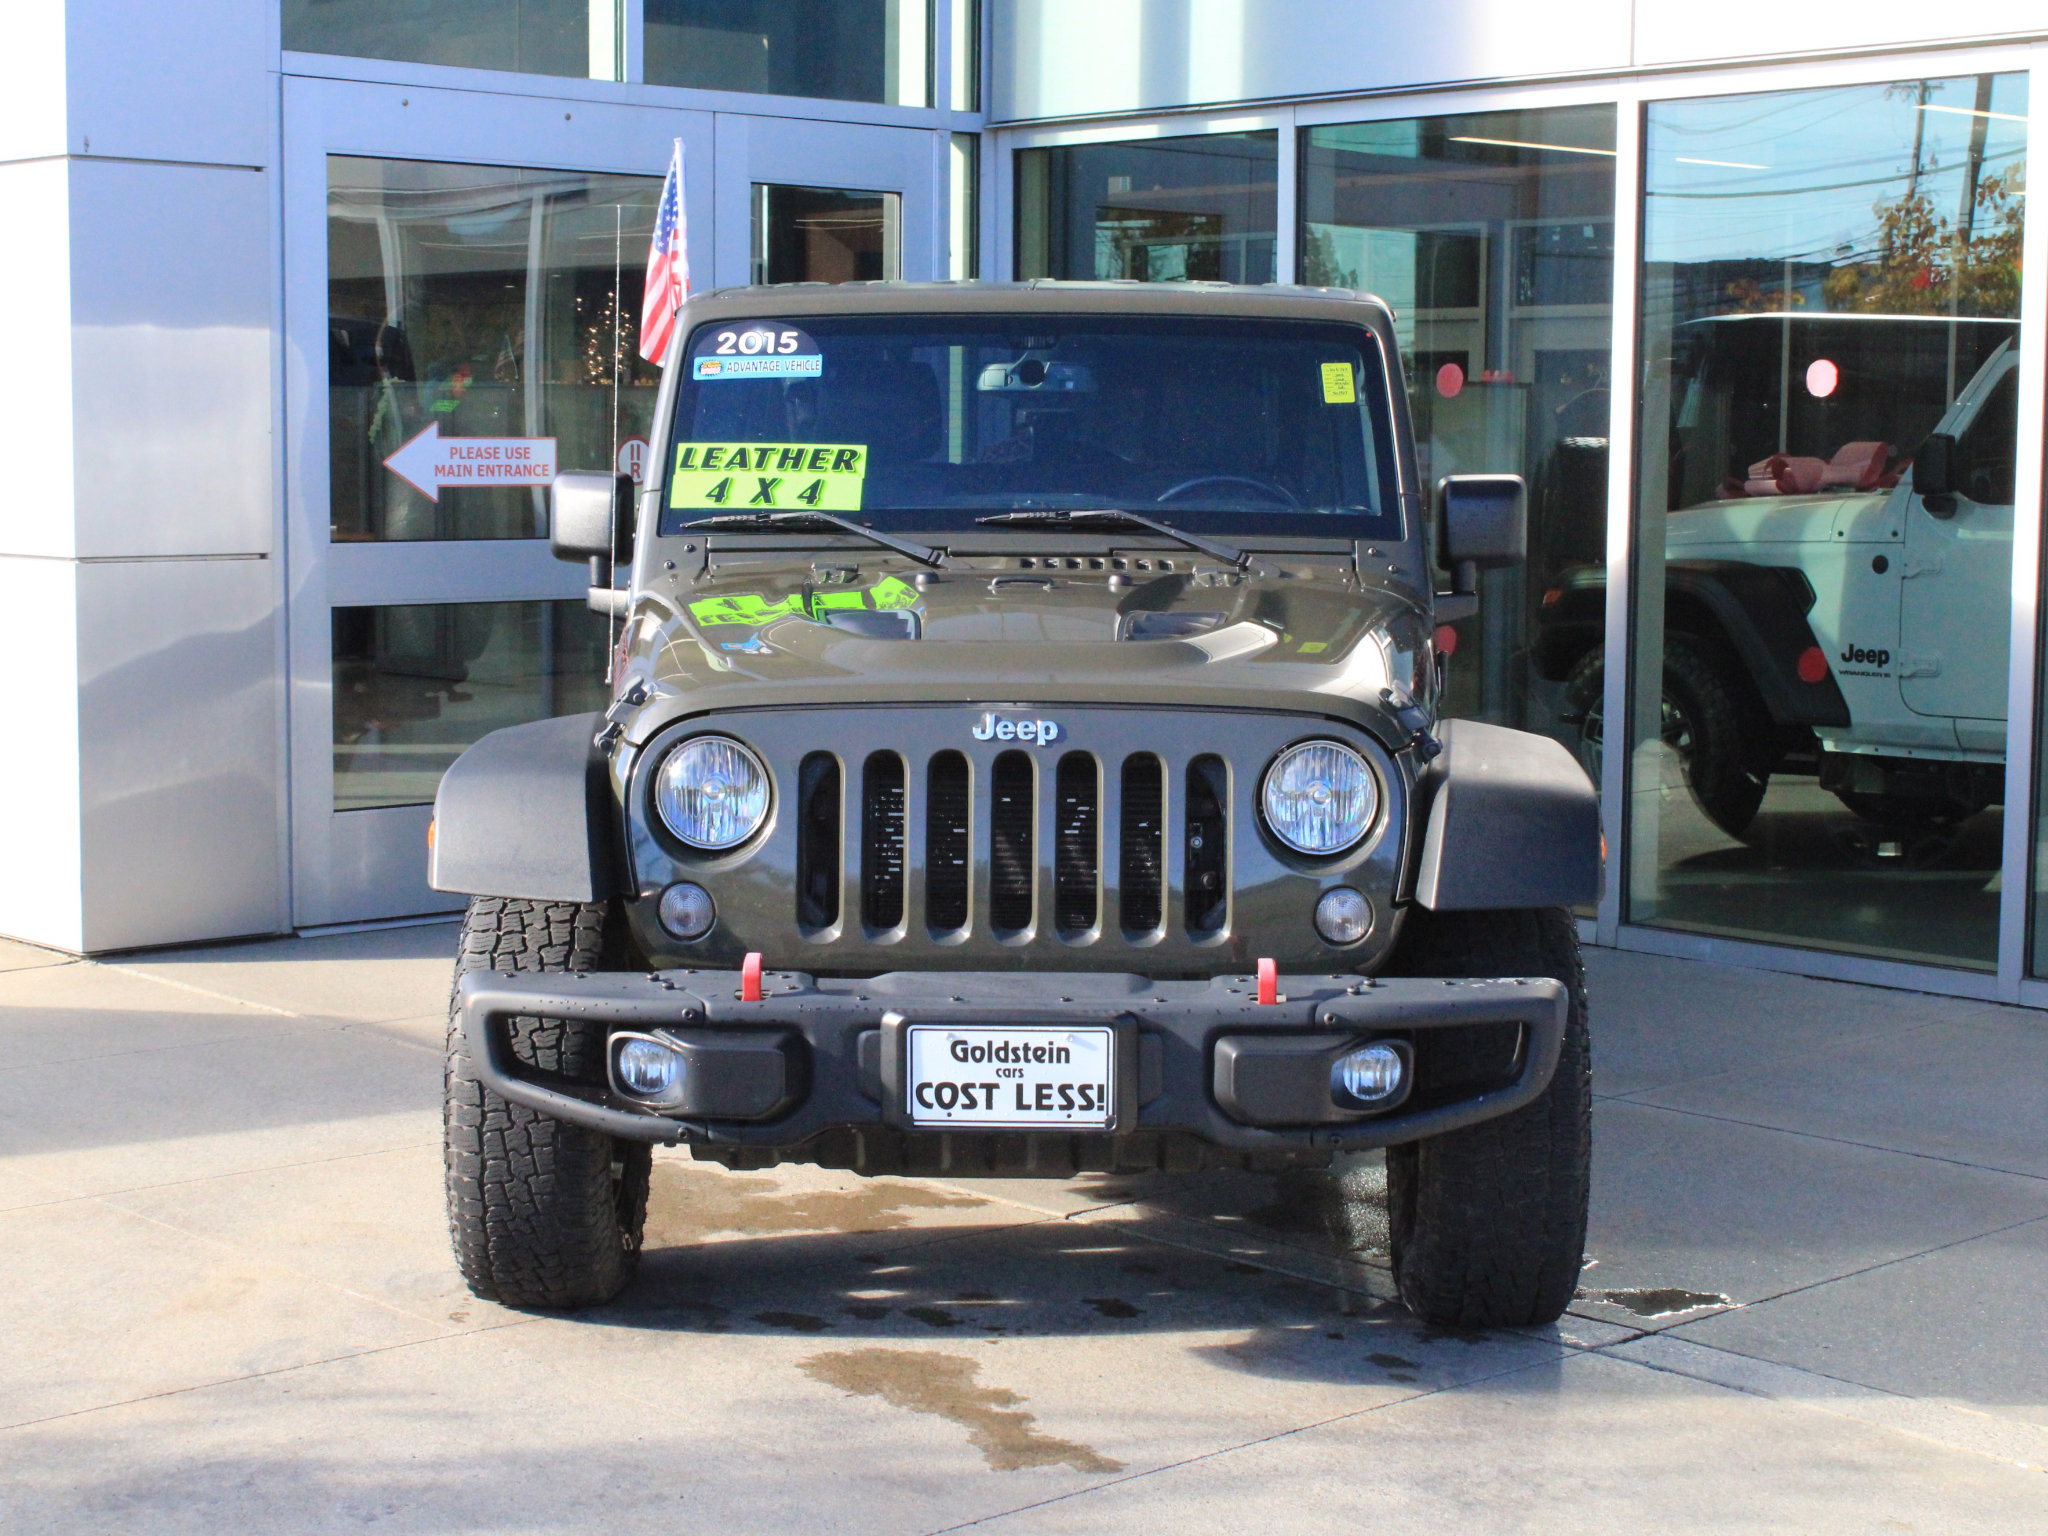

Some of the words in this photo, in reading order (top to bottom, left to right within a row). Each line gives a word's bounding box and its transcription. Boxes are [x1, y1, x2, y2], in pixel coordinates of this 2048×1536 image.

[716, 331, 799, 355] 2015
[726, 360, 780, 373] ADVANTAGE
[784, 359, 820, 371] VEHICLE
[449, 446, 501, 460] PLEASE
[505, 446, 531, 460] USE
[679, 446, 861, 473] LEATHER
[434, 464, 473, 477] MAIN
[477, 464, 550, 477] ENTRANCE
[705, 477, 731, 504] 4
[797, 478, 824, 506] 4
[1841, 643, 1890, 668] Jeep
[972, 713, 1059, 746] Jeep
[950, 1039, 1071, 1064] Goldstein
[995, 1067, 1025, 1078] cars
[915, 1081, 1000, 1110] COST
[1015, 1082, 1105, 1112] LESS!
